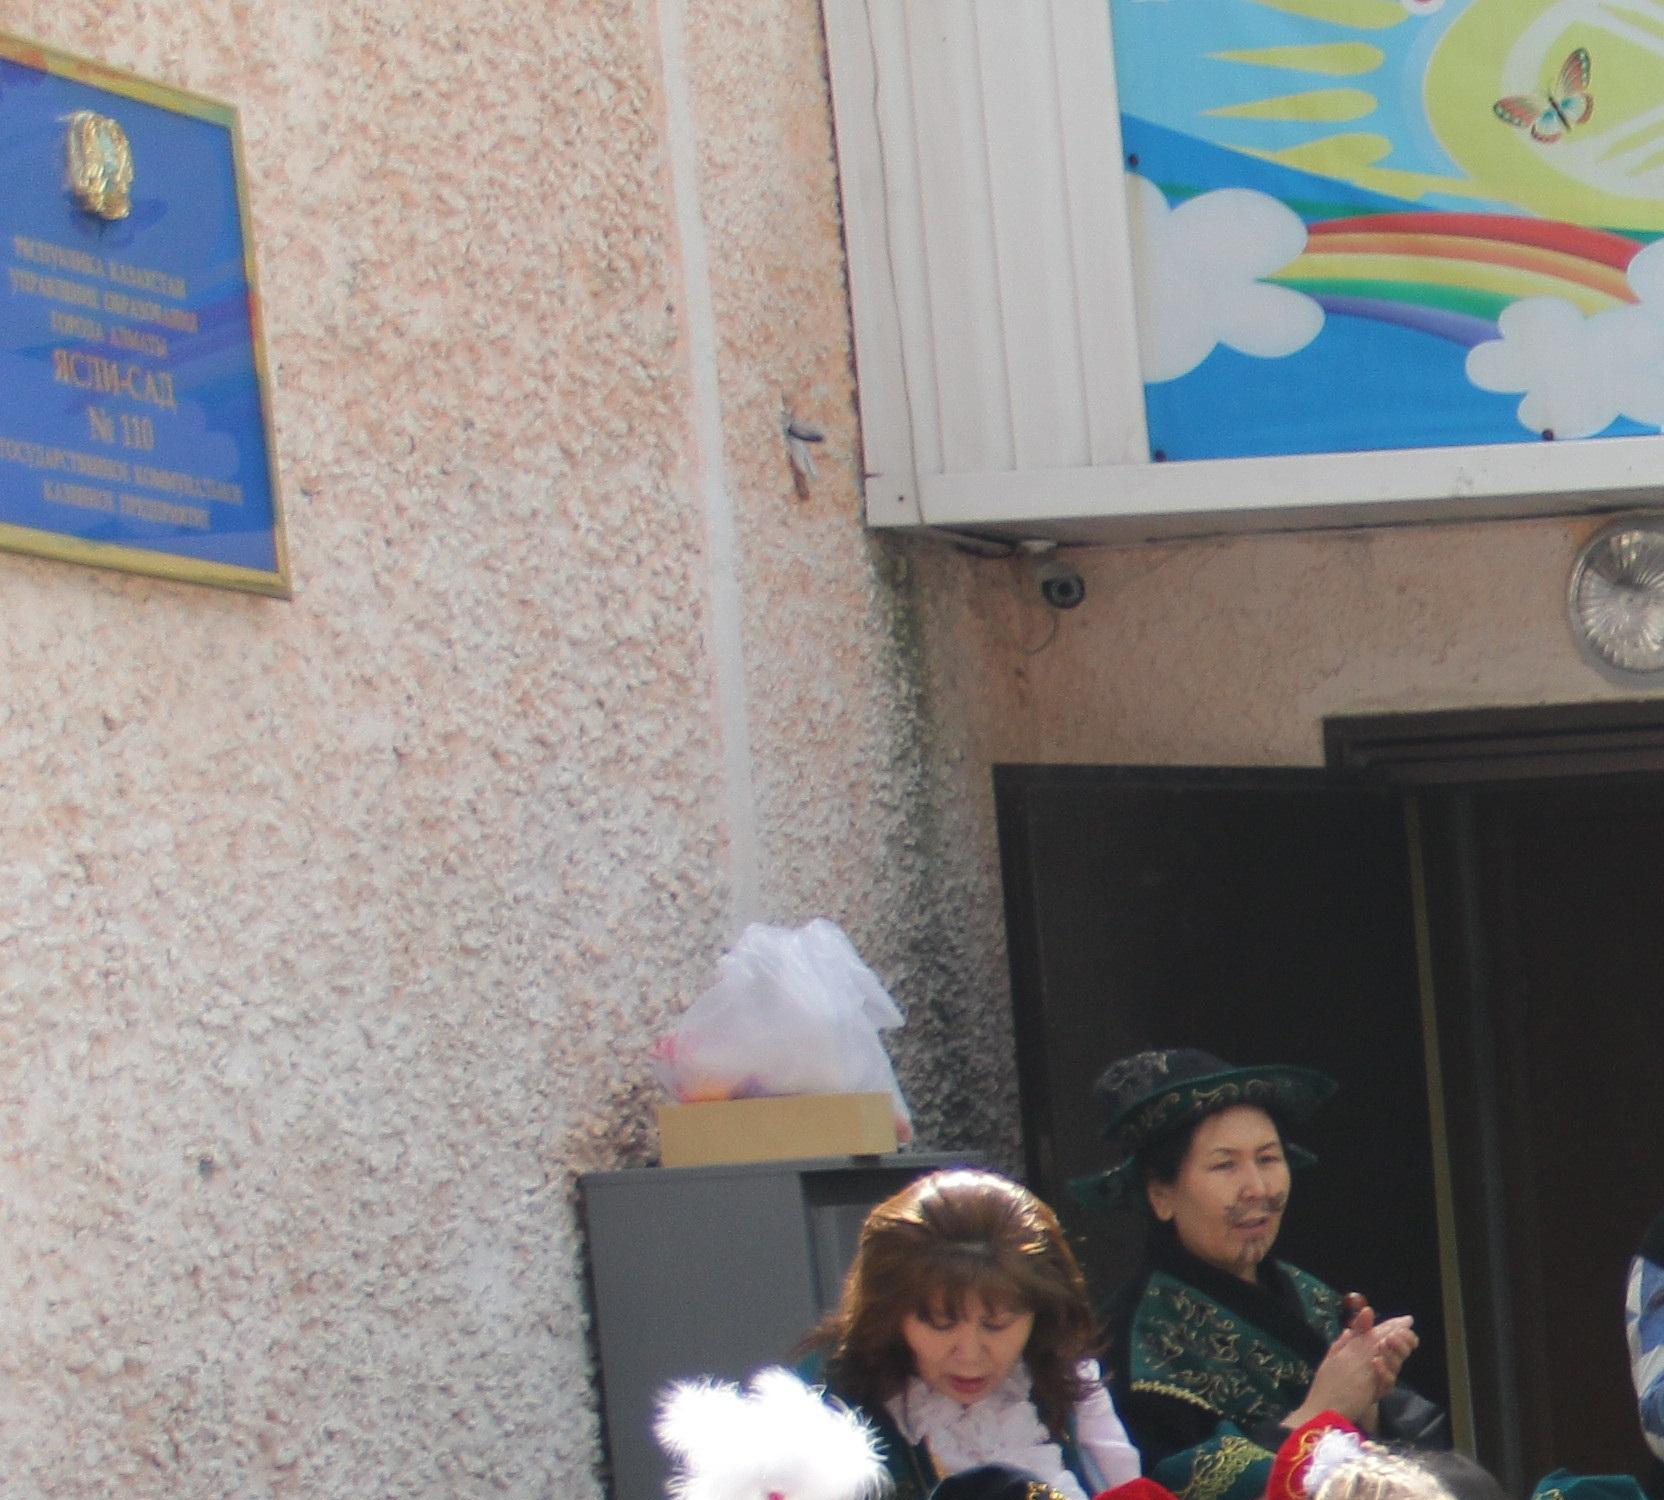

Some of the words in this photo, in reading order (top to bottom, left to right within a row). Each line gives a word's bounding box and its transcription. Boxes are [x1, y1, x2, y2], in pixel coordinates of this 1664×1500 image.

[54, 350, 176, 411] ЯСЛИ-САД
[88, 405, 116, 442] №
[119, 414, 154, 450] 110
